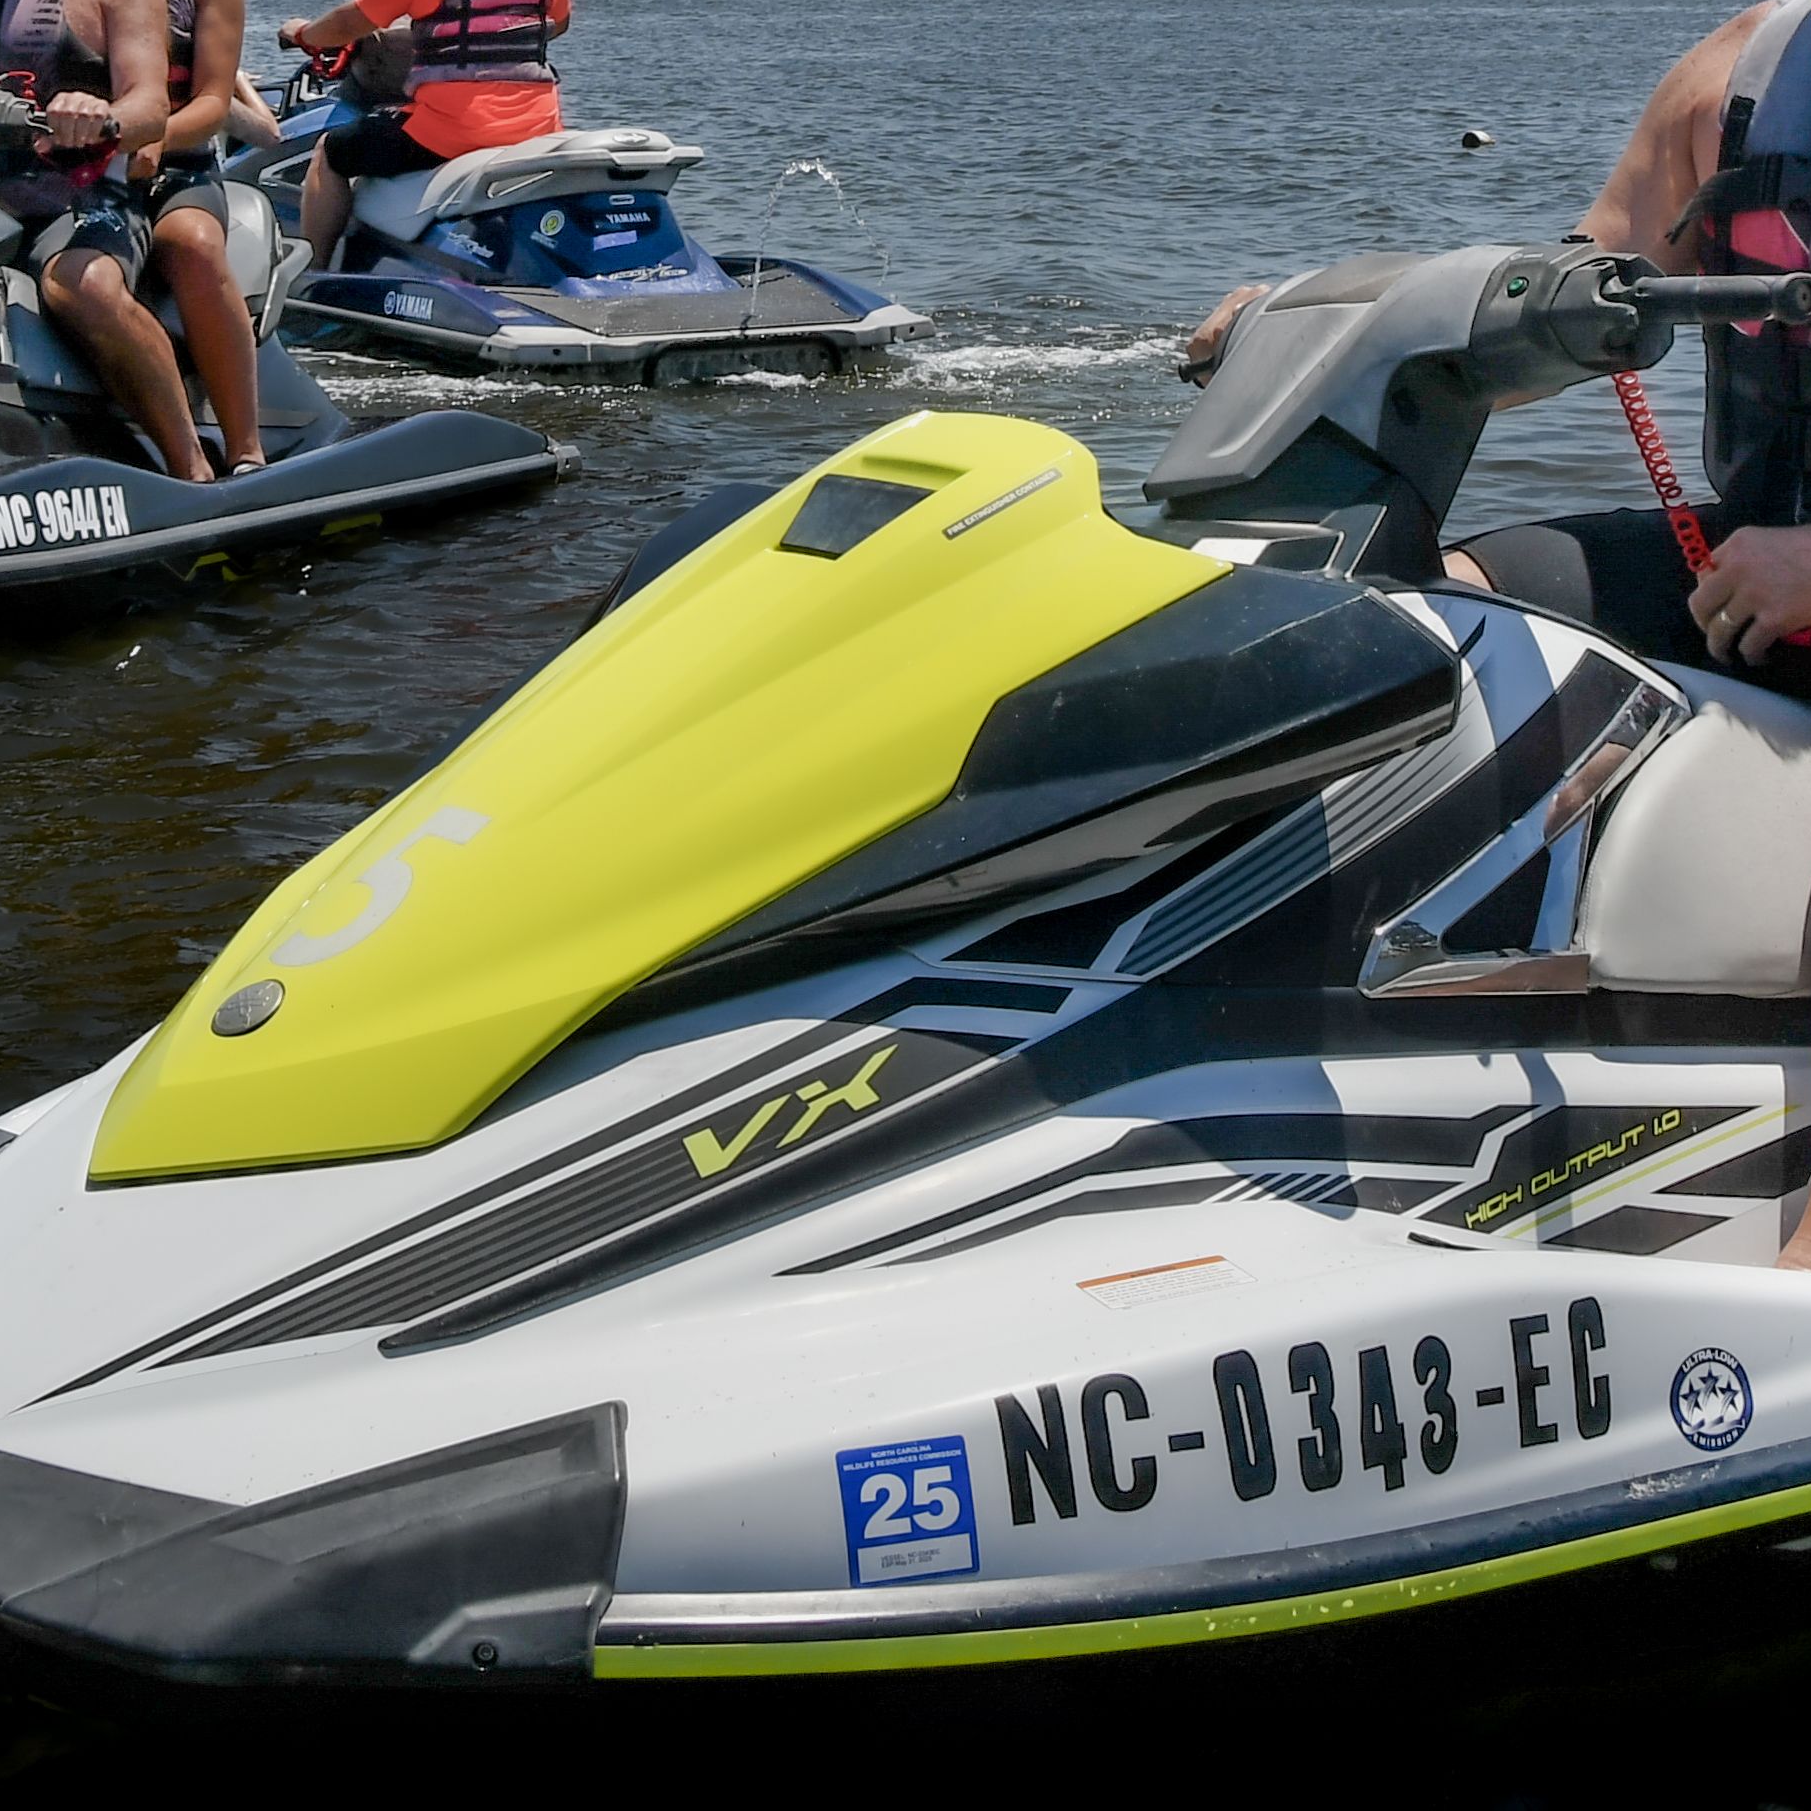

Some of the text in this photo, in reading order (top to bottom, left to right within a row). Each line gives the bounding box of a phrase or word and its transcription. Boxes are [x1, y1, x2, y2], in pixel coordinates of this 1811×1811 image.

[606, 212, 651, 224] YAMAHA
[395, 294, 434, 320] YAMAHA
[34, 487, 102, 544] 9644
[98, 485, 131, 538] EN
[947, 469, 1057, 536] FIRE EXTINGUISHER CONTAINER
[269, 804, 492, 967] 5
[682, 1043, 899, 1179] VX
[1464, 1108, 1682, 1229] HIGH OUTPUT 1.0
[1681, 1348, 1739, 1374] ULTRA-LOW
[994, 1296, 1612, 1526] NC-0343-EC
[842, 1449, 962, 1472] WILDLIFE RESOURCES COMMISSION
[870, 1444, 932, 1459] NORTH CAROLINA
[859, 1465, 961, 1540] 25
